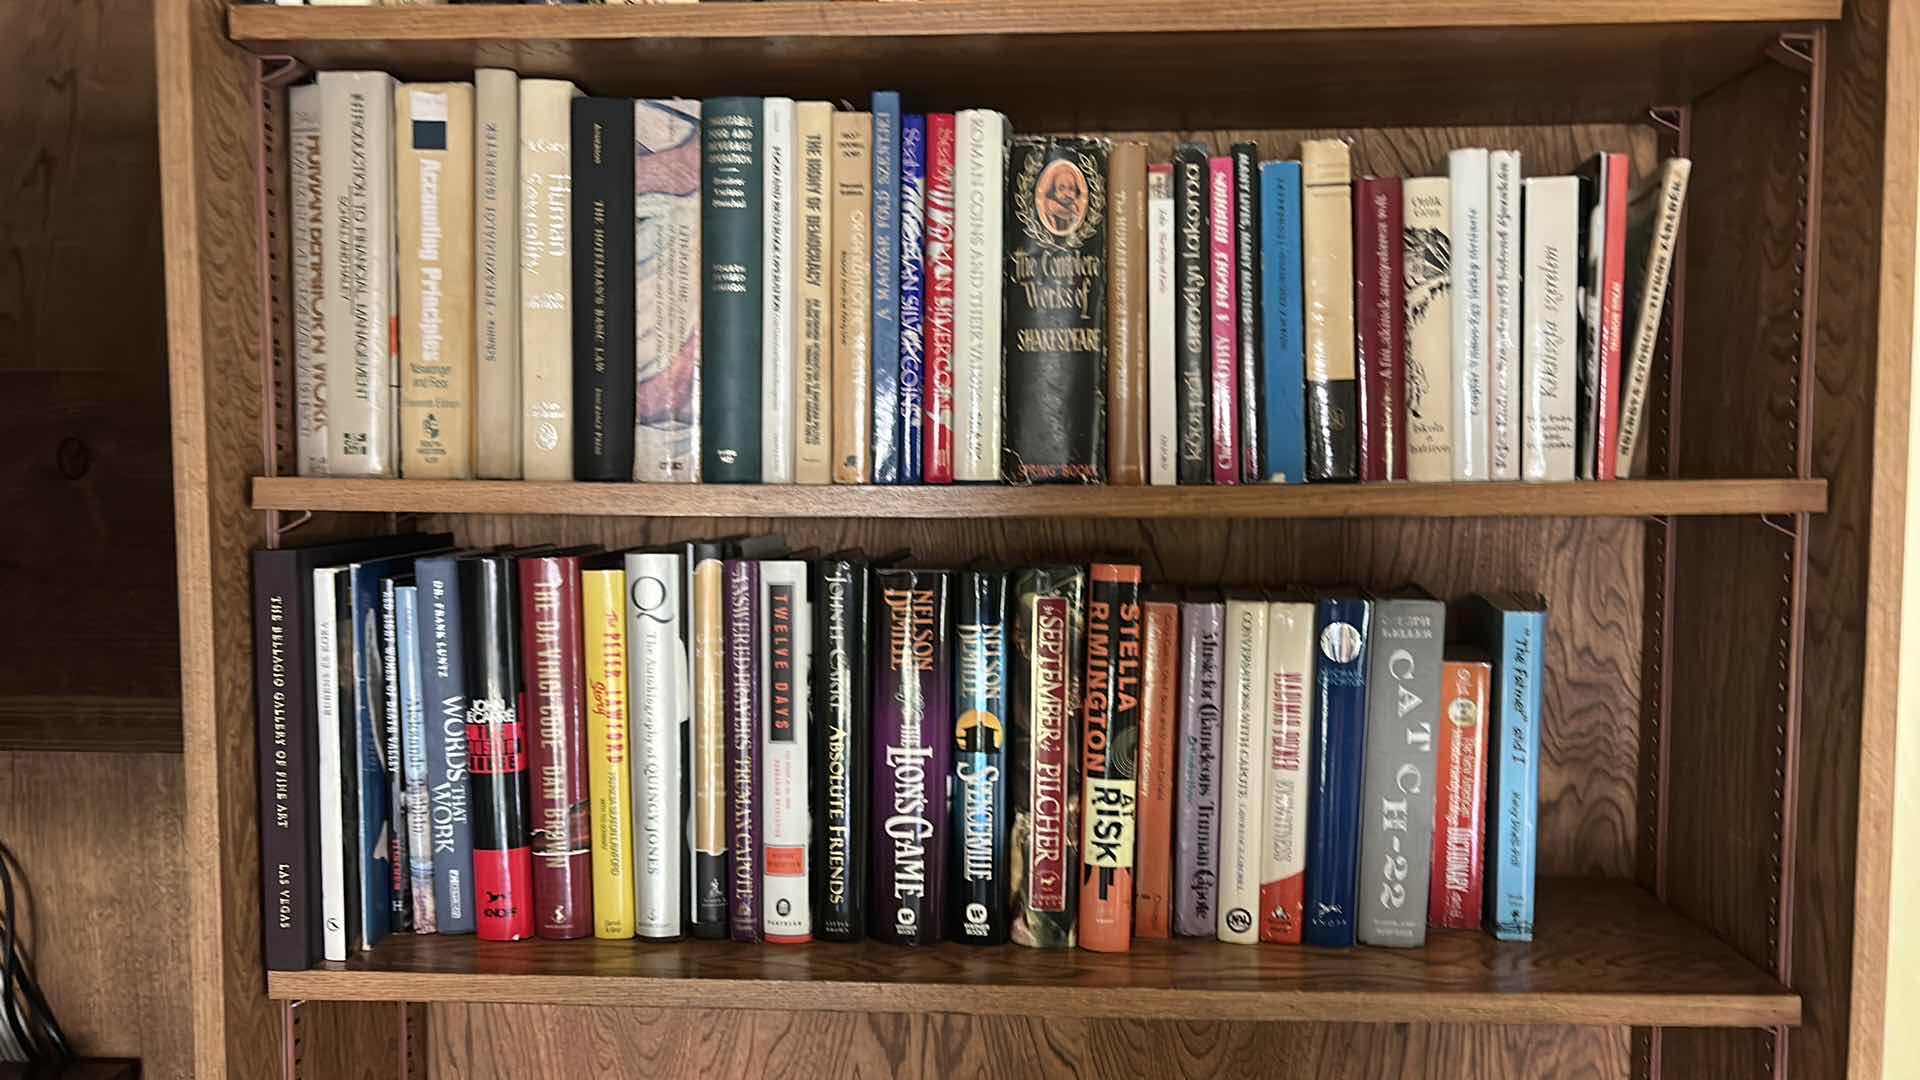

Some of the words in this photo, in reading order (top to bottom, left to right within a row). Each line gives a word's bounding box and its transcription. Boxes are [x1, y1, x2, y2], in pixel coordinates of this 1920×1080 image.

[806, 135, 822, 156] THE
[969, 117, 986, 187] ROMAN
[1237, 153, 1252, 191] MANY
[419, 159, 443, 262] Accounting
[548, 172, 572, 257] Human
[968, 190, 985, 247] COINS
[805, 216, 823, 287] DEMOCRACY
[968, 248, 985, 290] AND
[1239, 231, 1253, 269] MANY
[1023, 281, 1069, 312] Works
[1537, 245, 1564, 311] szerelem
[420, 266, 444, 362] Principles
[967, 291, 985, 339] THEIR
[1016, 328, 1102, 354] SHAKESPEARE
[271, 595, 283, 620] THE
[434, 603, 446, 638] FRANK
[533, 581, 561, 613] THE
[631, 576, 675, 624] Q
[731, 575, 751, 669] ANSWERED
[823, 575, 852, 620] JOHN
[383, 613, 395, 642] LIGHT
[535, 621, 561, 643] DA
[645, 632, 658, 652] The
[774, 592, 790, 670] TWELVE
[884, 588, 912, 671] DEMILLE
[911, 588, 934, 671] NELSON
[272, 626, 284, 687] BELLAGIO
[384, 647, 396, 681] WOMEN
[435, 641, 448, 678] LUNTZ
[536, 646, 562, 698] VINCI
[603, 633, 622, 678] PETER
[983, 623, 1002, 698] NELSON
[1034, 614, 1063, 741] SEPTEMBER
[1118, 601, 1139, 713] STELLA
[1200, 632, 1219, 677] Music
[1239, 611, 1253, 711] CONVERSATIONS
[386, 685, 396, 699] OF
[590, 678, 609, 717] Story
[643, 658, 659, 747] Autobiography
[775, 681, 790, 730] DAYS
[1086, 600, 1110, 773] RIMINGTON
[1200, 679, 1218, 701] for
[273, 692, 286, 746] GALLERY
[386, 703, 397, 732] DEATH
[441, 695, 468, 782] WORDS
[540, 705, 564, 749] CODE
[606, 690, 624, 764] LAWFORD
[1239, 713, 1251, 747] WITH
[1512, 725, 1526, 751] and
[275, 751, 287, 766] OF
[387, 736, 399, 773] VALLEY
[828, 724, 849, 818] ABSOLUTE
[1199, 703, 1219, 796] Chameleons
[276, 771, 288, 799] FINE
[542, 766, 565, 799] DAN
[644, 763, 660, 824] QUINCY
[734, 759, 752, 830] TRUMAN
[886, 744, 934, 813] LION'S
[1381, 648, 1432, 910] CATCH-22
[277, 804, 289, 828] ART
[431, 781, 455, 854] WORK
[450, 784, 467, 825] THAT
[956, 760, 999, 880] SPENCERVILLE
[1033, 759, 1063, 867] PILCHER
[1092, 784, 1125, 863] RISK
[1121, 793, 1136, 817] AT
[544, 808, 569, 869] BROWN
[645, 828, 661, 876] JONES
[884, 814, 935, 899] GAME
[1196, 800, 1215, 867] Truman
[279, 863, 290, 885] LAS
[735, 832, 753, 899] CAPOTE
[829, 824, 848, 904] FRIENDS
[1445, 828, 1474, 893] DICTIONARY
[279, 890, 291, 928] VEGAS
[1191, 869, 1216, 920] Capote
